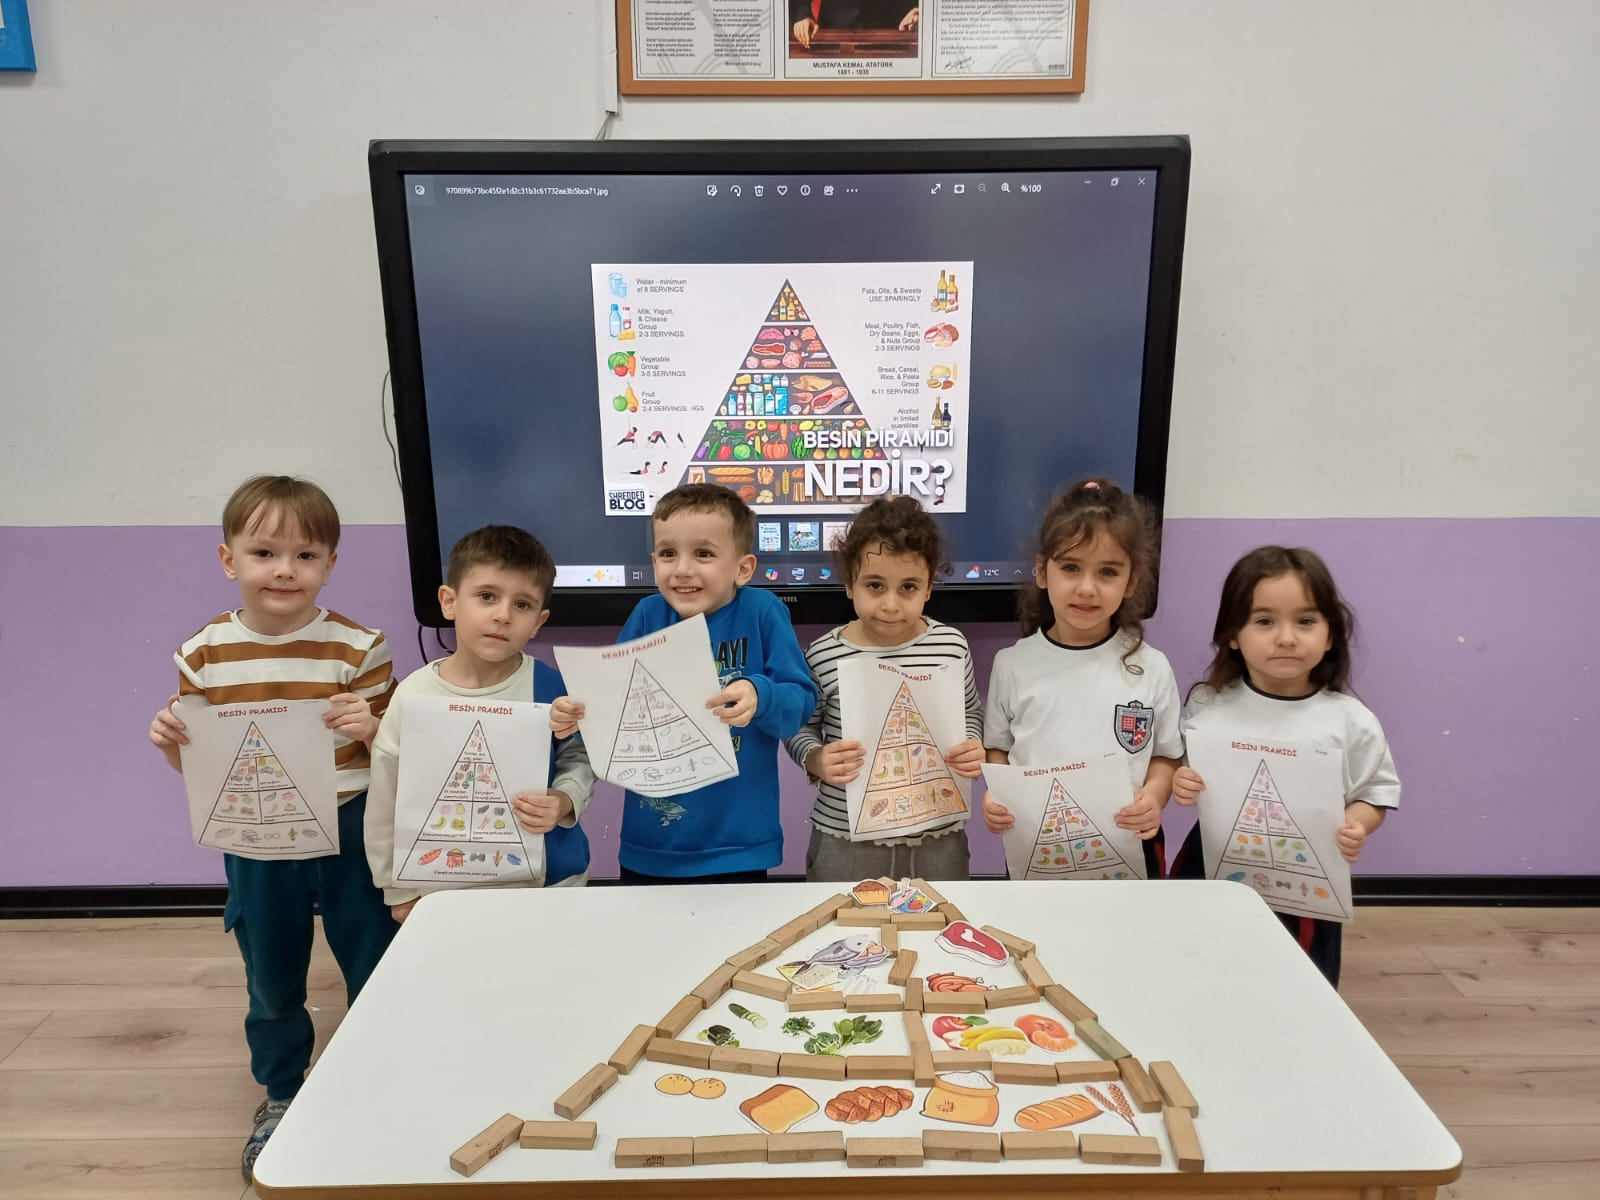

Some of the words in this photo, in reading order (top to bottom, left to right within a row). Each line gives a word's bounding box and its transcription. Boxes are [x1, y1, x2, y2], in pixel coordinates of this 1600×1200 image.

[1021, 184, 1042, 193] %100
[869, 330, 880, 338] Dry
[866, 427, 954, 448] PİRAMİDİ
[804, 449, 953, 496] NEDİR?
[610, 499, 646, 510] BLOG
[983, 568, 1000, 577] 12°C
[715, 637, 748, 670] AY!
